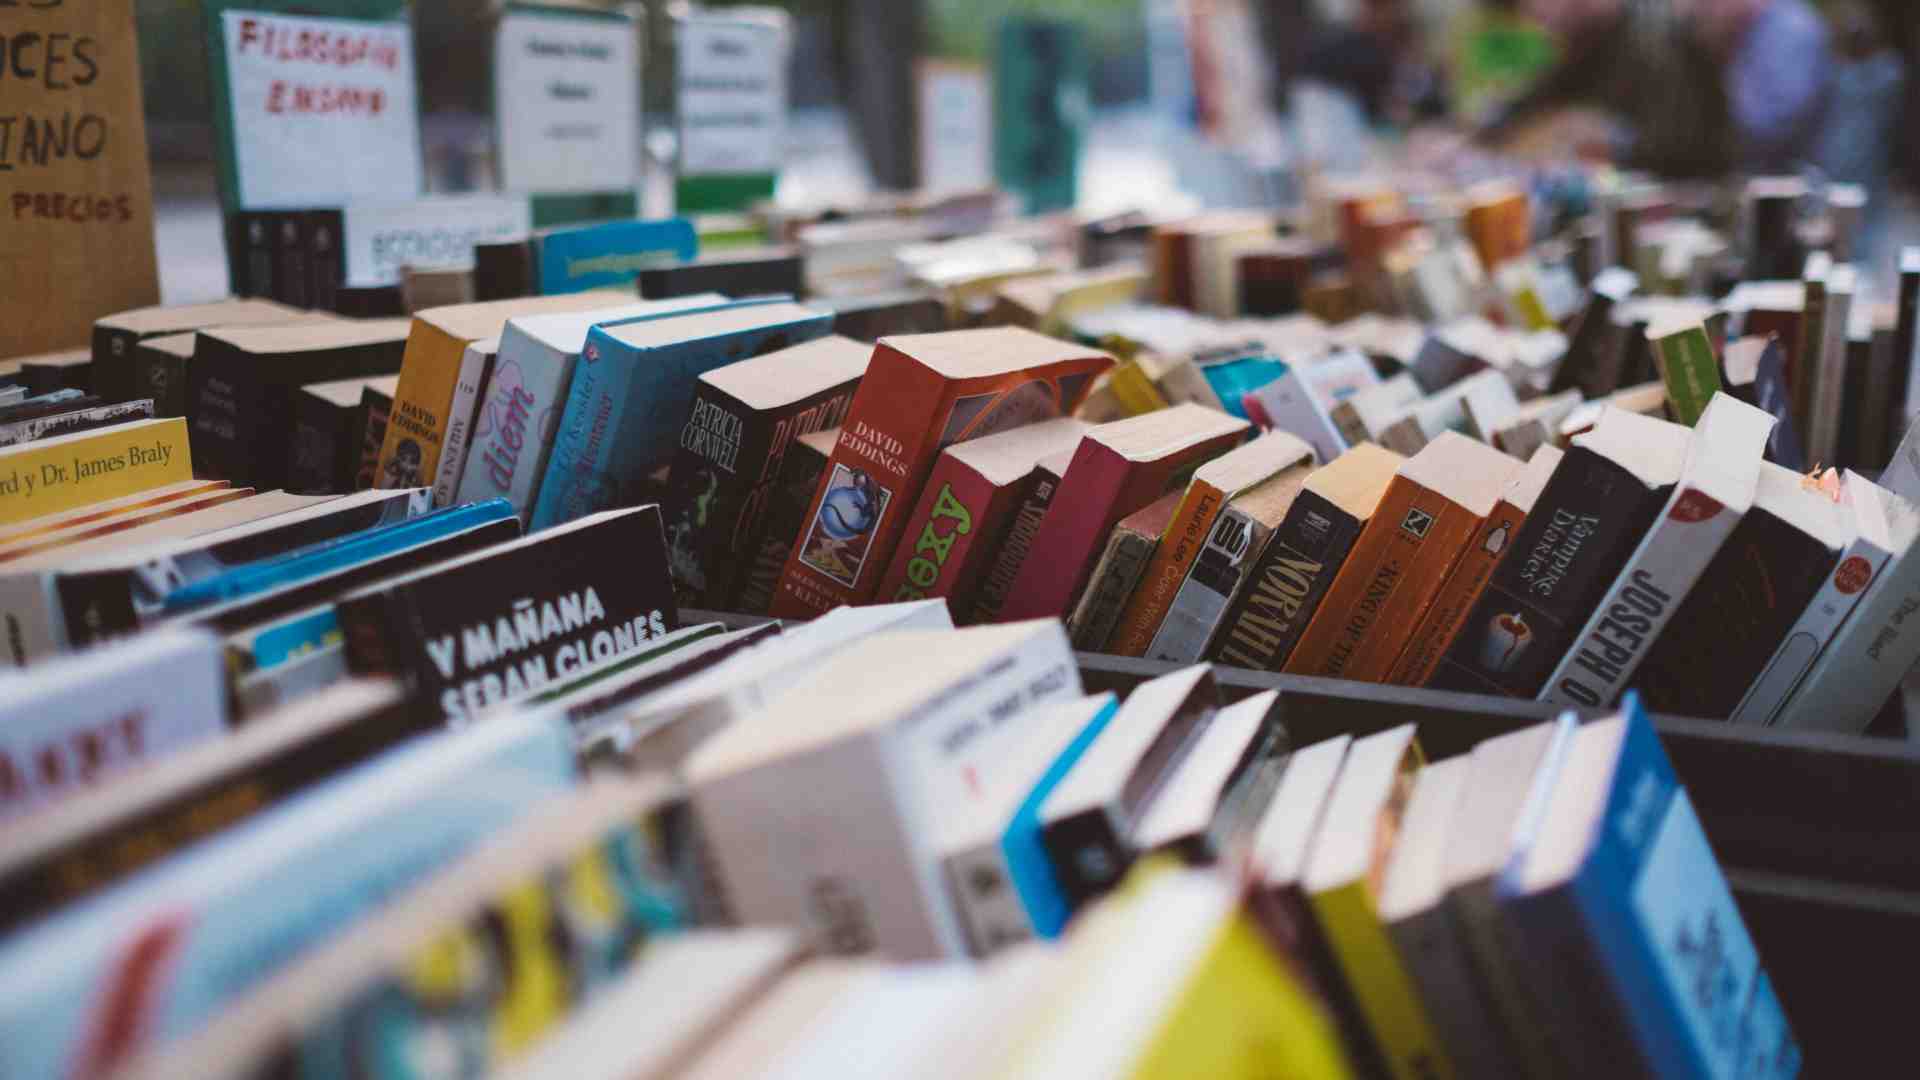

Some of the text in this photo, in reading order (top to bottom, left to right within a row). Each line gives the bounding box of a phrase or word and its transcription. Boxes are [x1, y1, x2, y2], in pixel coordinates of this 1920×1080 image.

[680, 421, 738, 474] CORNWELL
[692, 397, 744, 447] PATRICIA
[855, 421, 903, 455] DAVID
[24, 472, 34, 497] y
[41, 464, 69, 486] Dr.
[74, 454, 126, 484] James
[128, 441, 172, 466] Braly
[839, 431, 909, 477] EDDINGS
[1231, 541, 1324, 656] NORAH
[1572, 567, 1671, 675] JOSEPH
[424, 585, 605, 678] Y MAÑANA
[554, 609, 667, 678] CLONES
